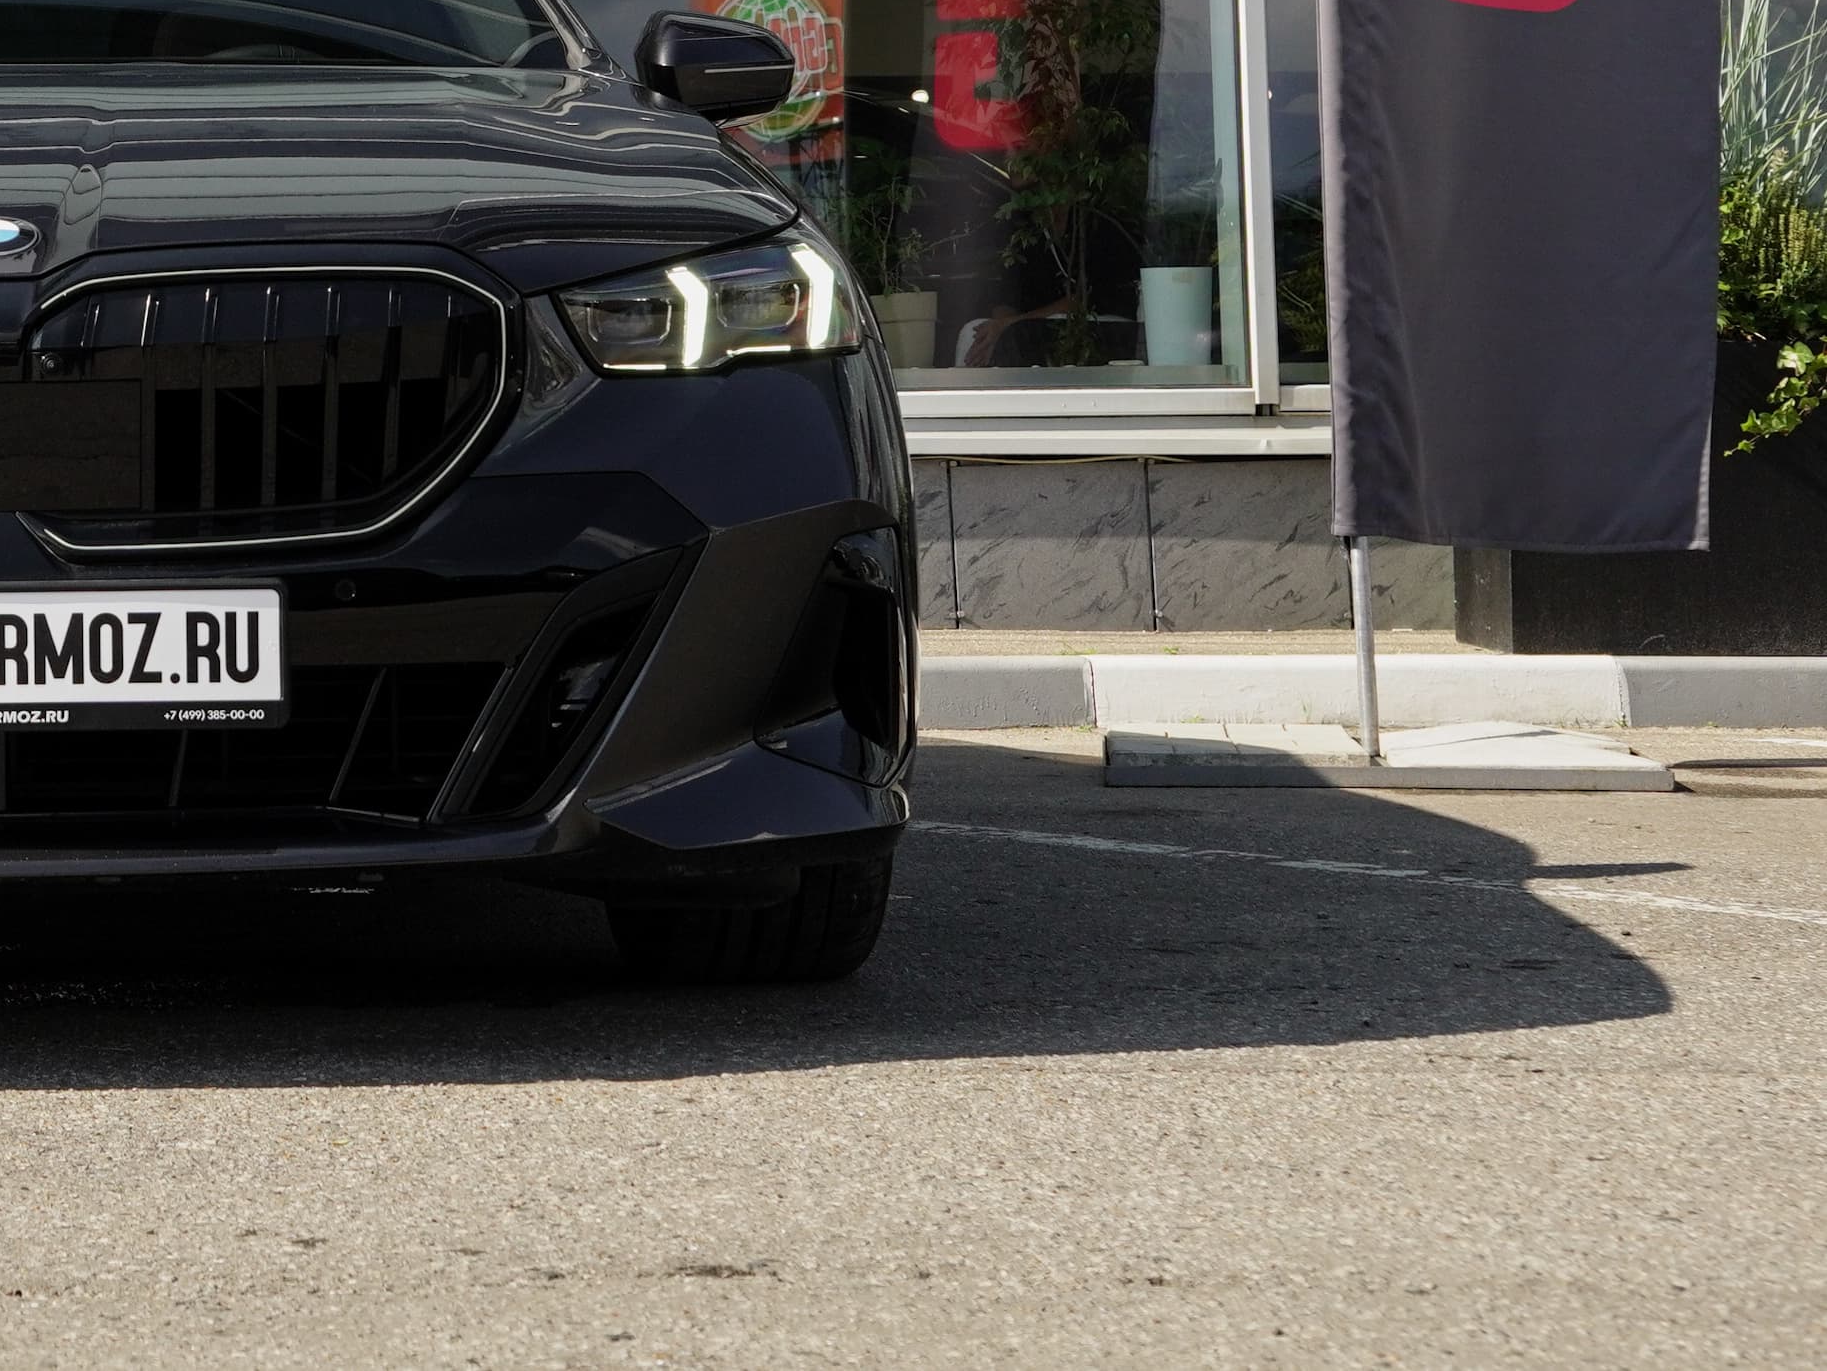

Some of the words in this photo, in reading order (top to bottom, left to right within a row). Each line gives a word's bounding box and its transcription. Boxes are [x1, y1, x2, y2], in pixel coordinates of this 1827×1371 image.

[163, 710, 177, 721] +7
[178, 709, 206, 722] (499)
[207, 709, 265, 721] 385-00-00
